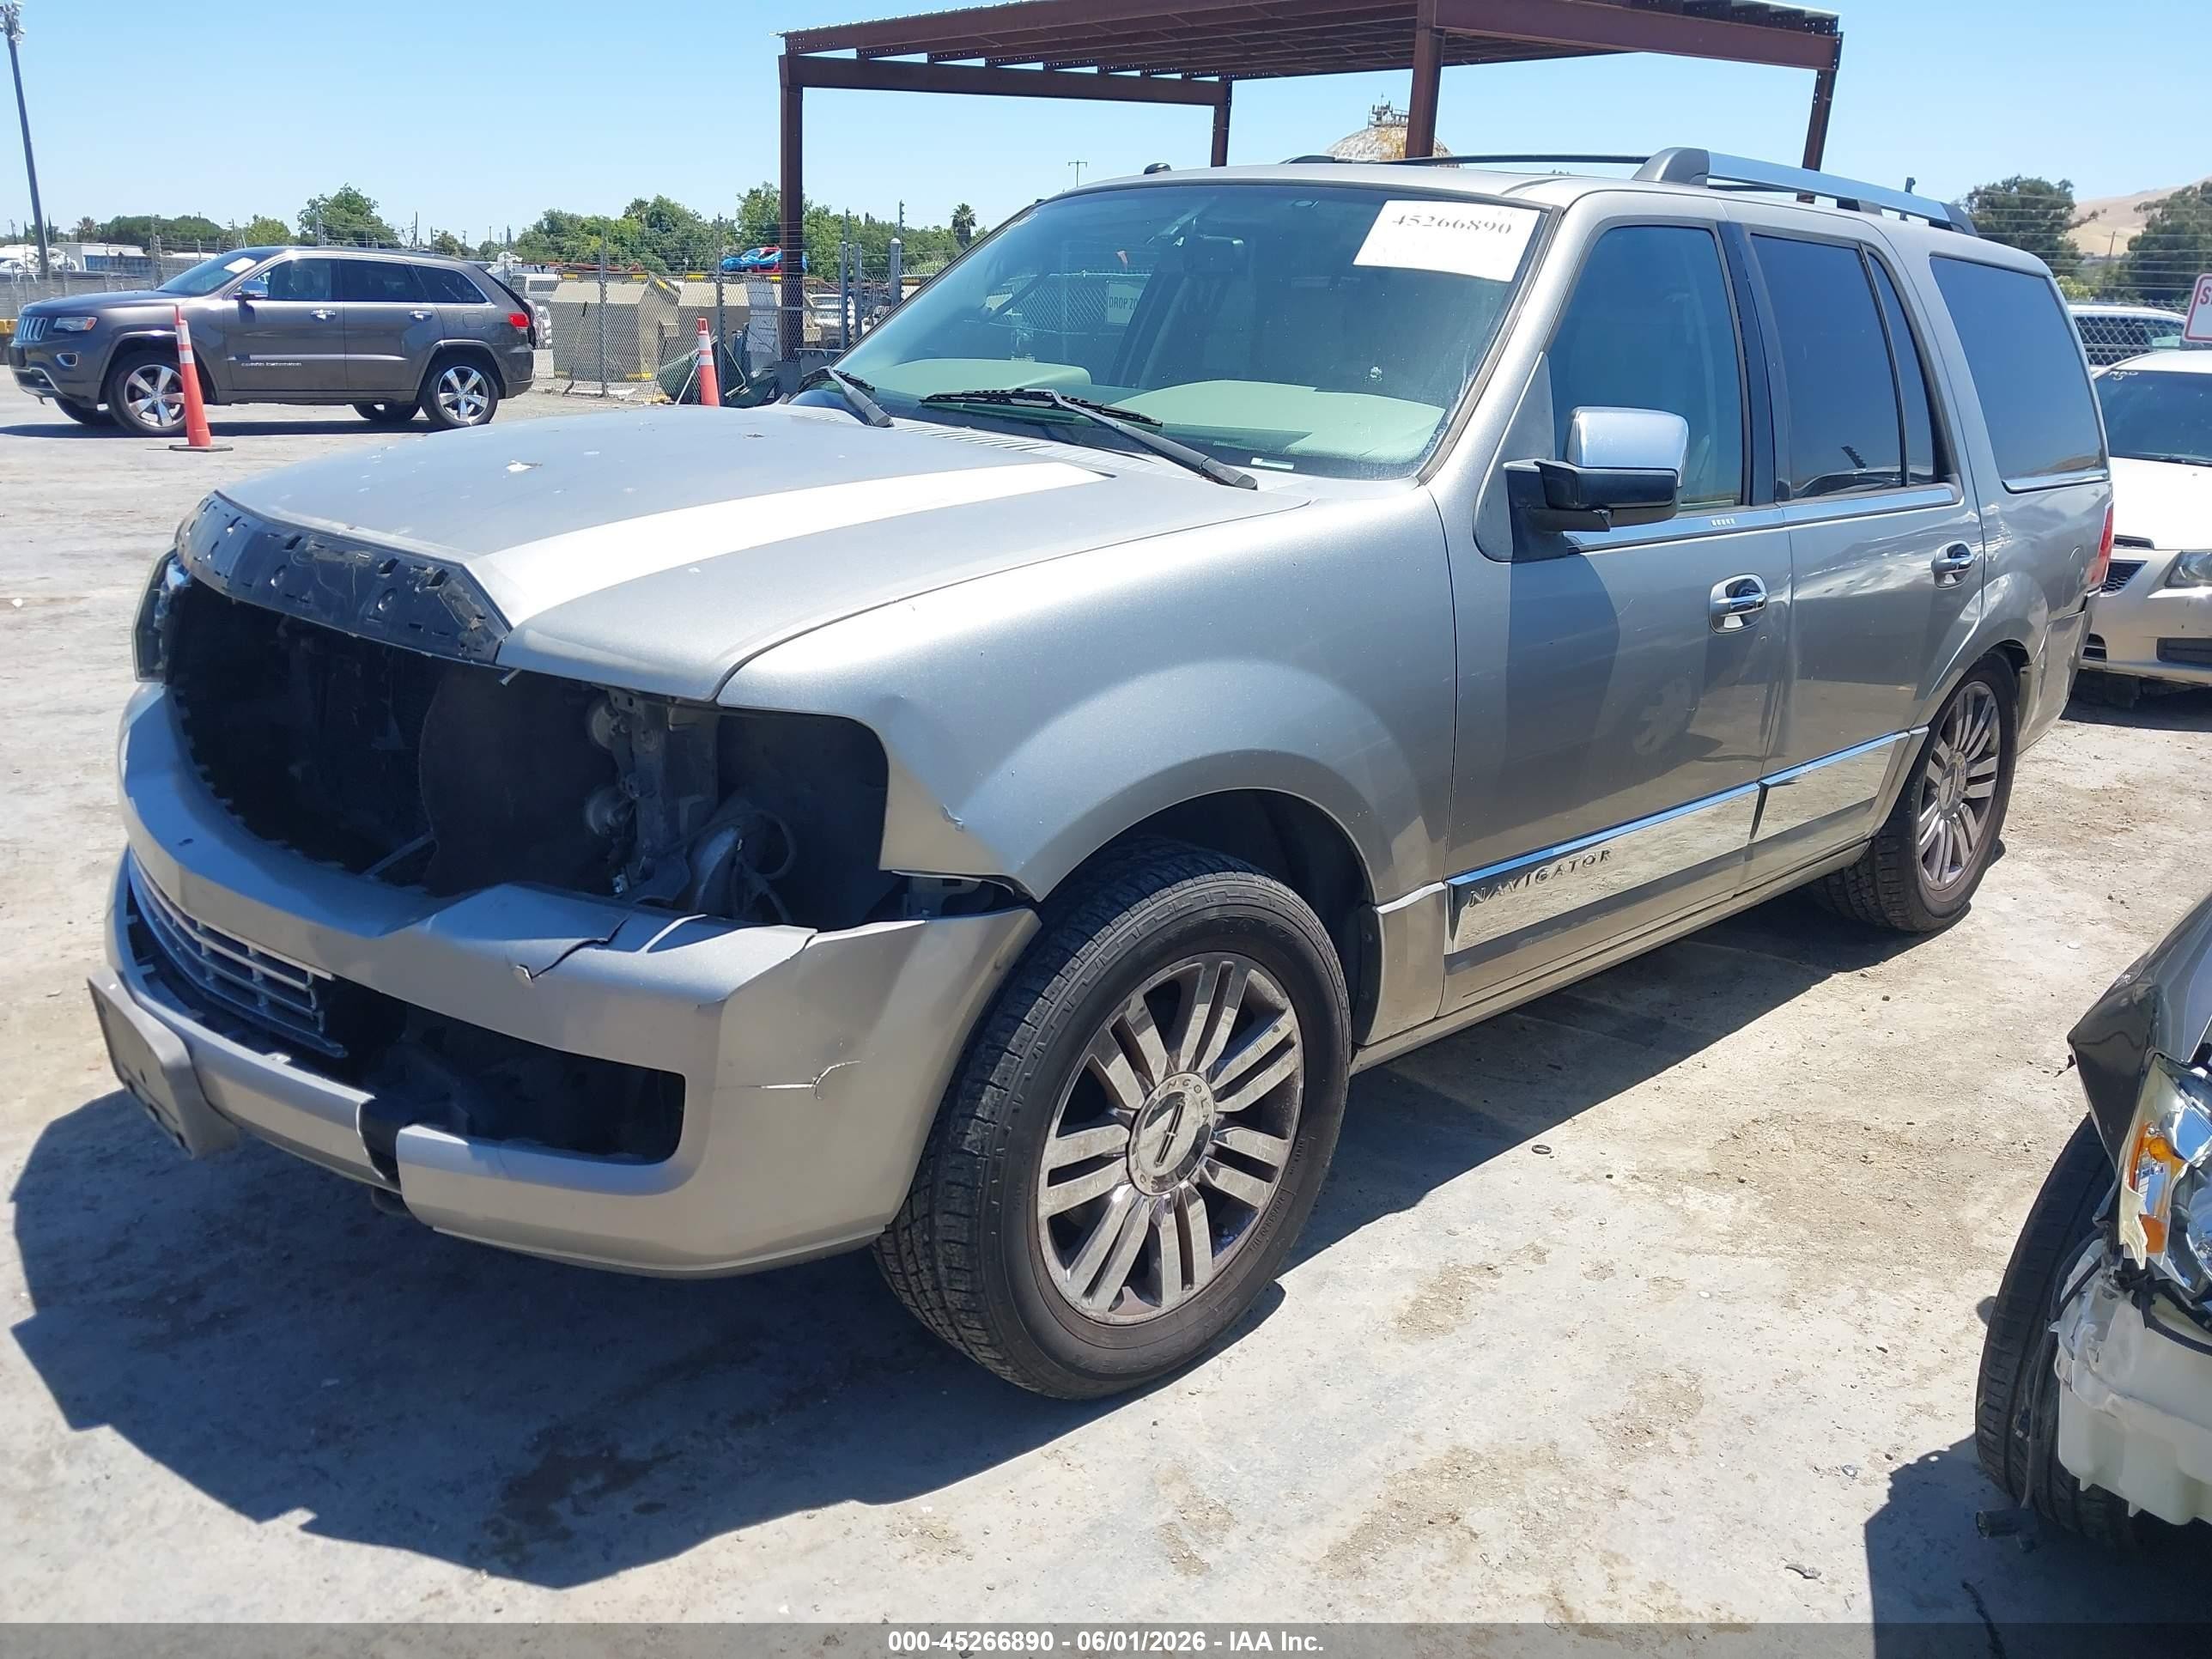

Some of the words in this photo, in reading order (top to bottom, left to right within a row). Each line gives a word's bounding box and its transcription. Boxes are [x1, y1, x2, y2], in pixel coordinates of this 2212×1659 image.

[1392, 215, 1512, 234] 45266890
[1109, 296, 1128, 310] DROP
[1468, 848, 1613, 908] NAVIGATOR
